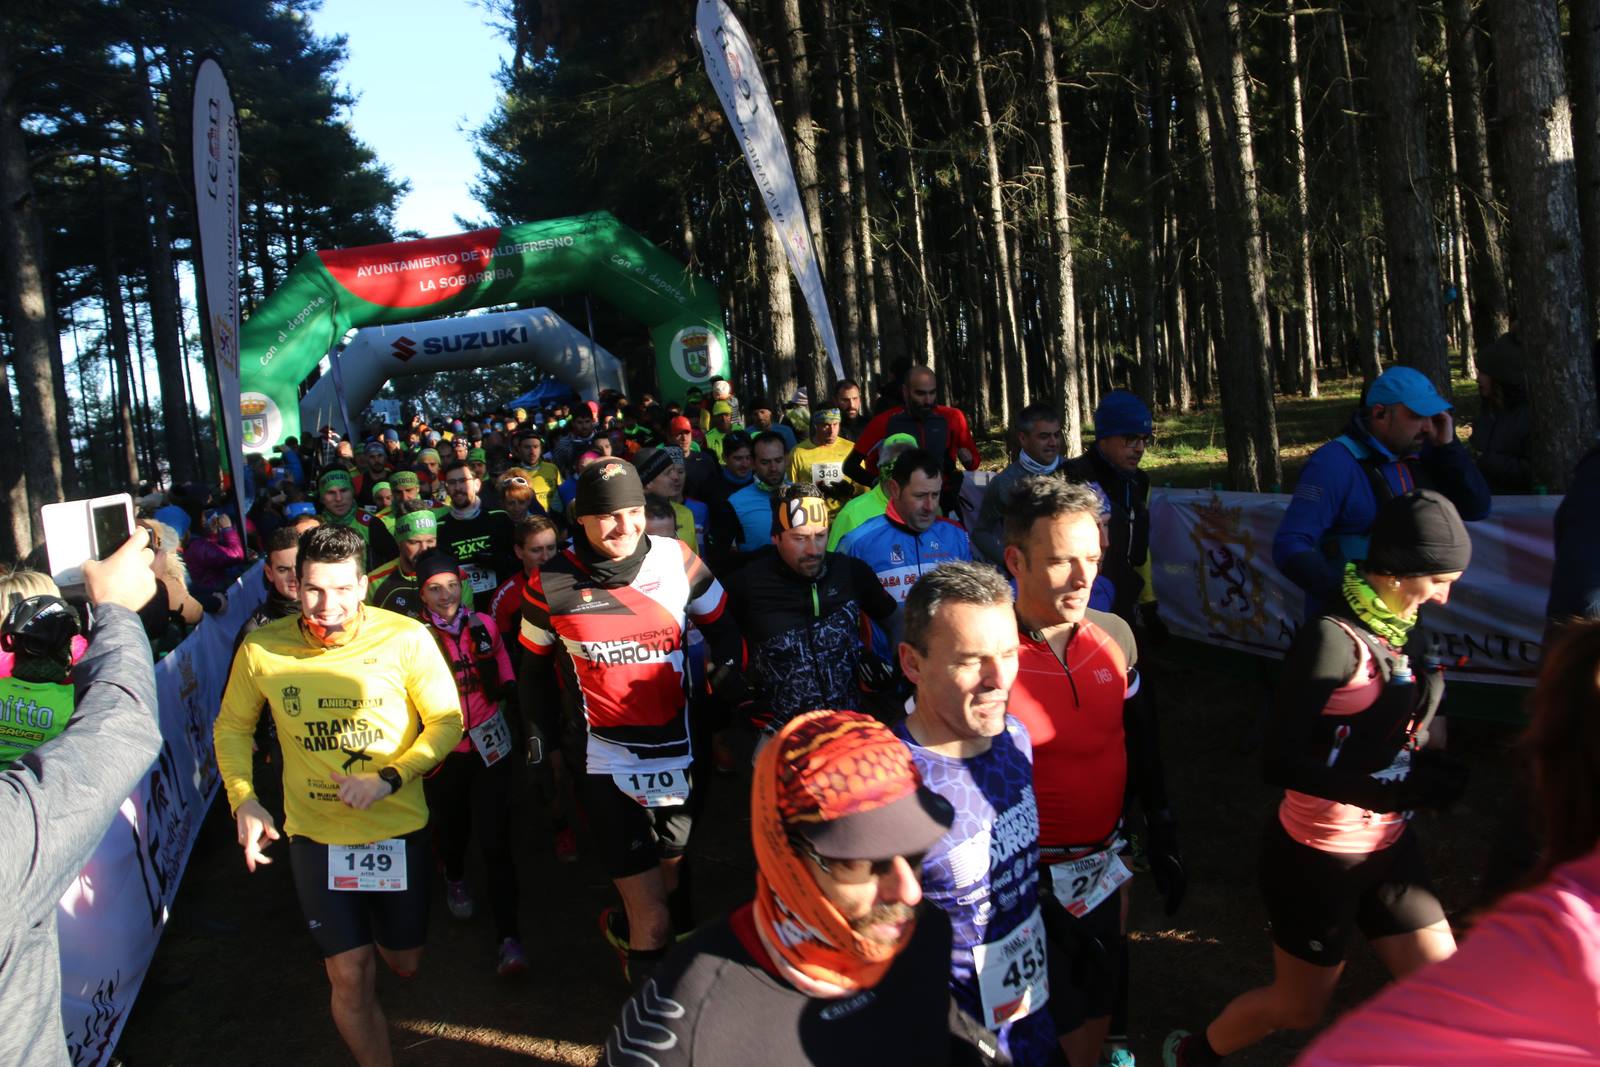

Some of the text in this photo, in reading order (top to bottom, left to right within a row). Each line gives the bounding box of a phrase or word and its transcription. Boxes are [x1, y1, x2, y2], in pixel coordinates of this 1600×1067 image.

[357, 236, 574, 278] AYUNTAMIENTO DE VALDEFRESNO
[610, 254, 632, 268] Con
[420, 268, 514, 292] LA SOBARRIBA
[260, 345, 278, 366] Con
[287, 297, 325, 331] deporte
[423, 326, 528, 355] SUZUKI
[819, 469, 838, 478] 348
[468, 570, 489, 582] 94
[591, 627, 674, 651] ATLETISMO
[596, 638, 675, 669] ARROYO
[304, 718, 368, 737] TRANS
[483, 724, 506, 750] 211
[629, 771, 674, 790] 170
[345, 853, 392, 872] 149
[1003, 936, 1046, 989] 453
